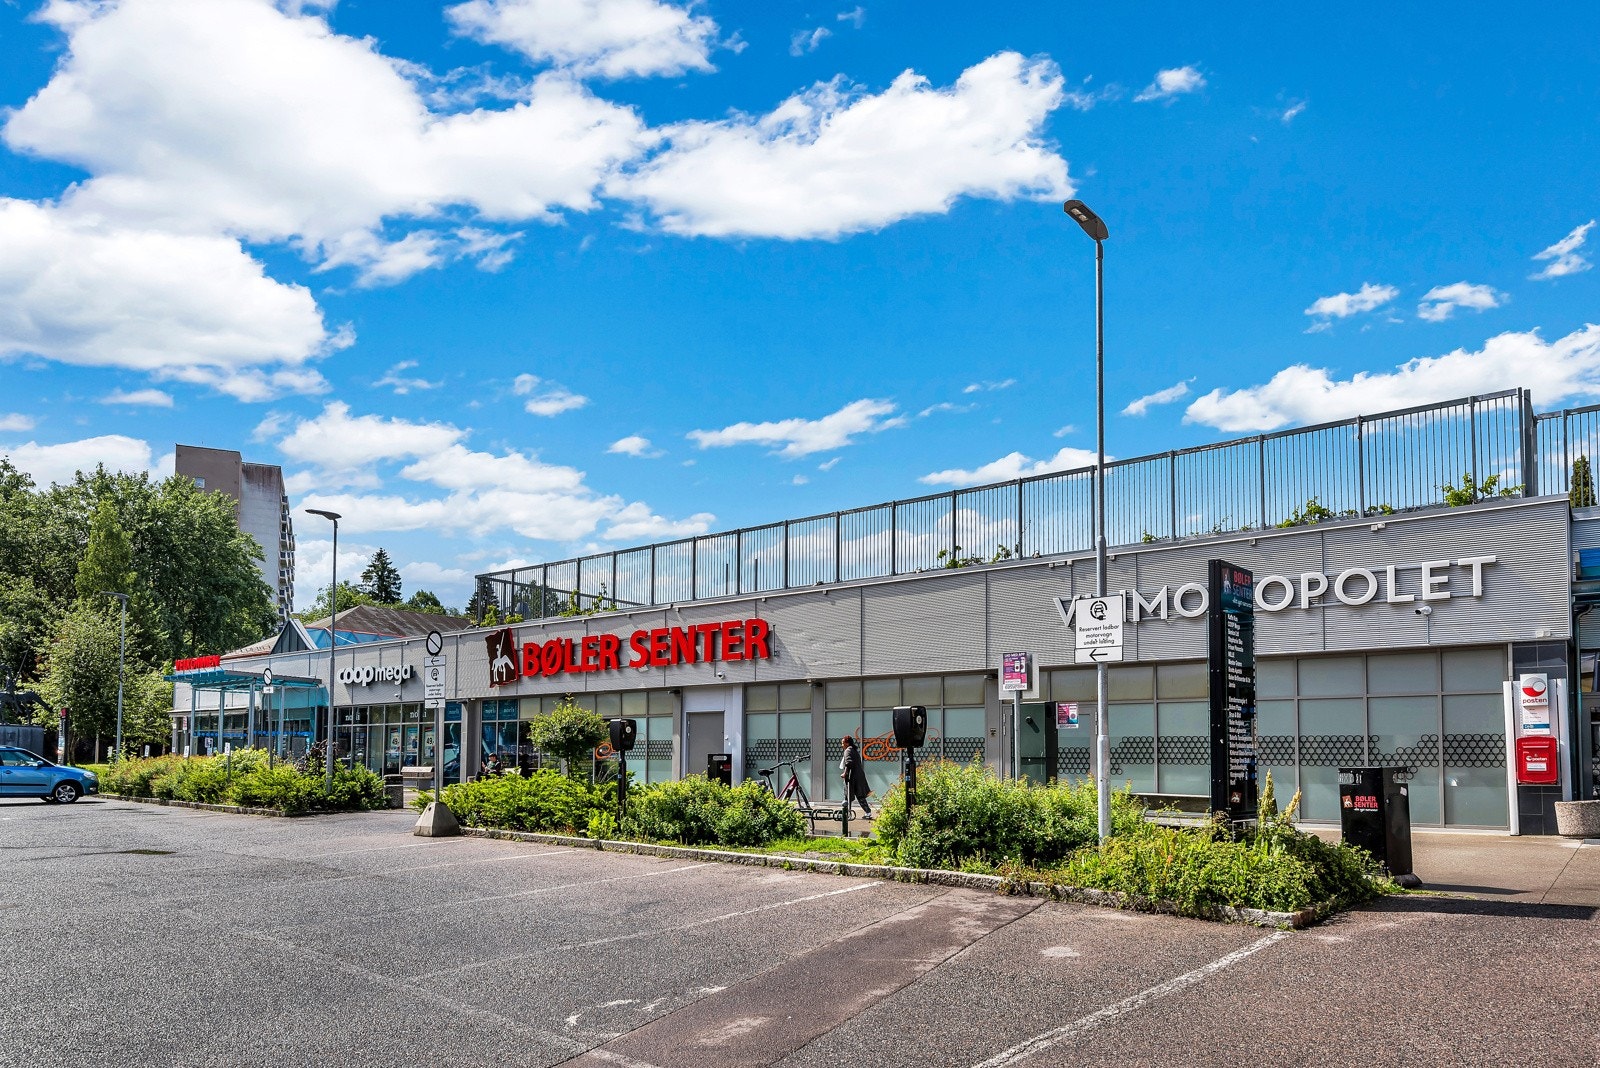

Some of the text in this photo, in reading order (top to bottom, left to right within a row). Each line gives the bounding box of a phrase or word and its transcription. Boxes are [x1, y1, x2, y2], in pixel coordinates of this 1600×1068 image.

[1103, 623, 1119, 631] ladbar
[523, 618, 769, 677] BØLER SENTER
[337, 664, 411, 687] coop mega
[1355, 795, 1376, 803] BØLER
[1353, 801, 1379, 809] SENTER
